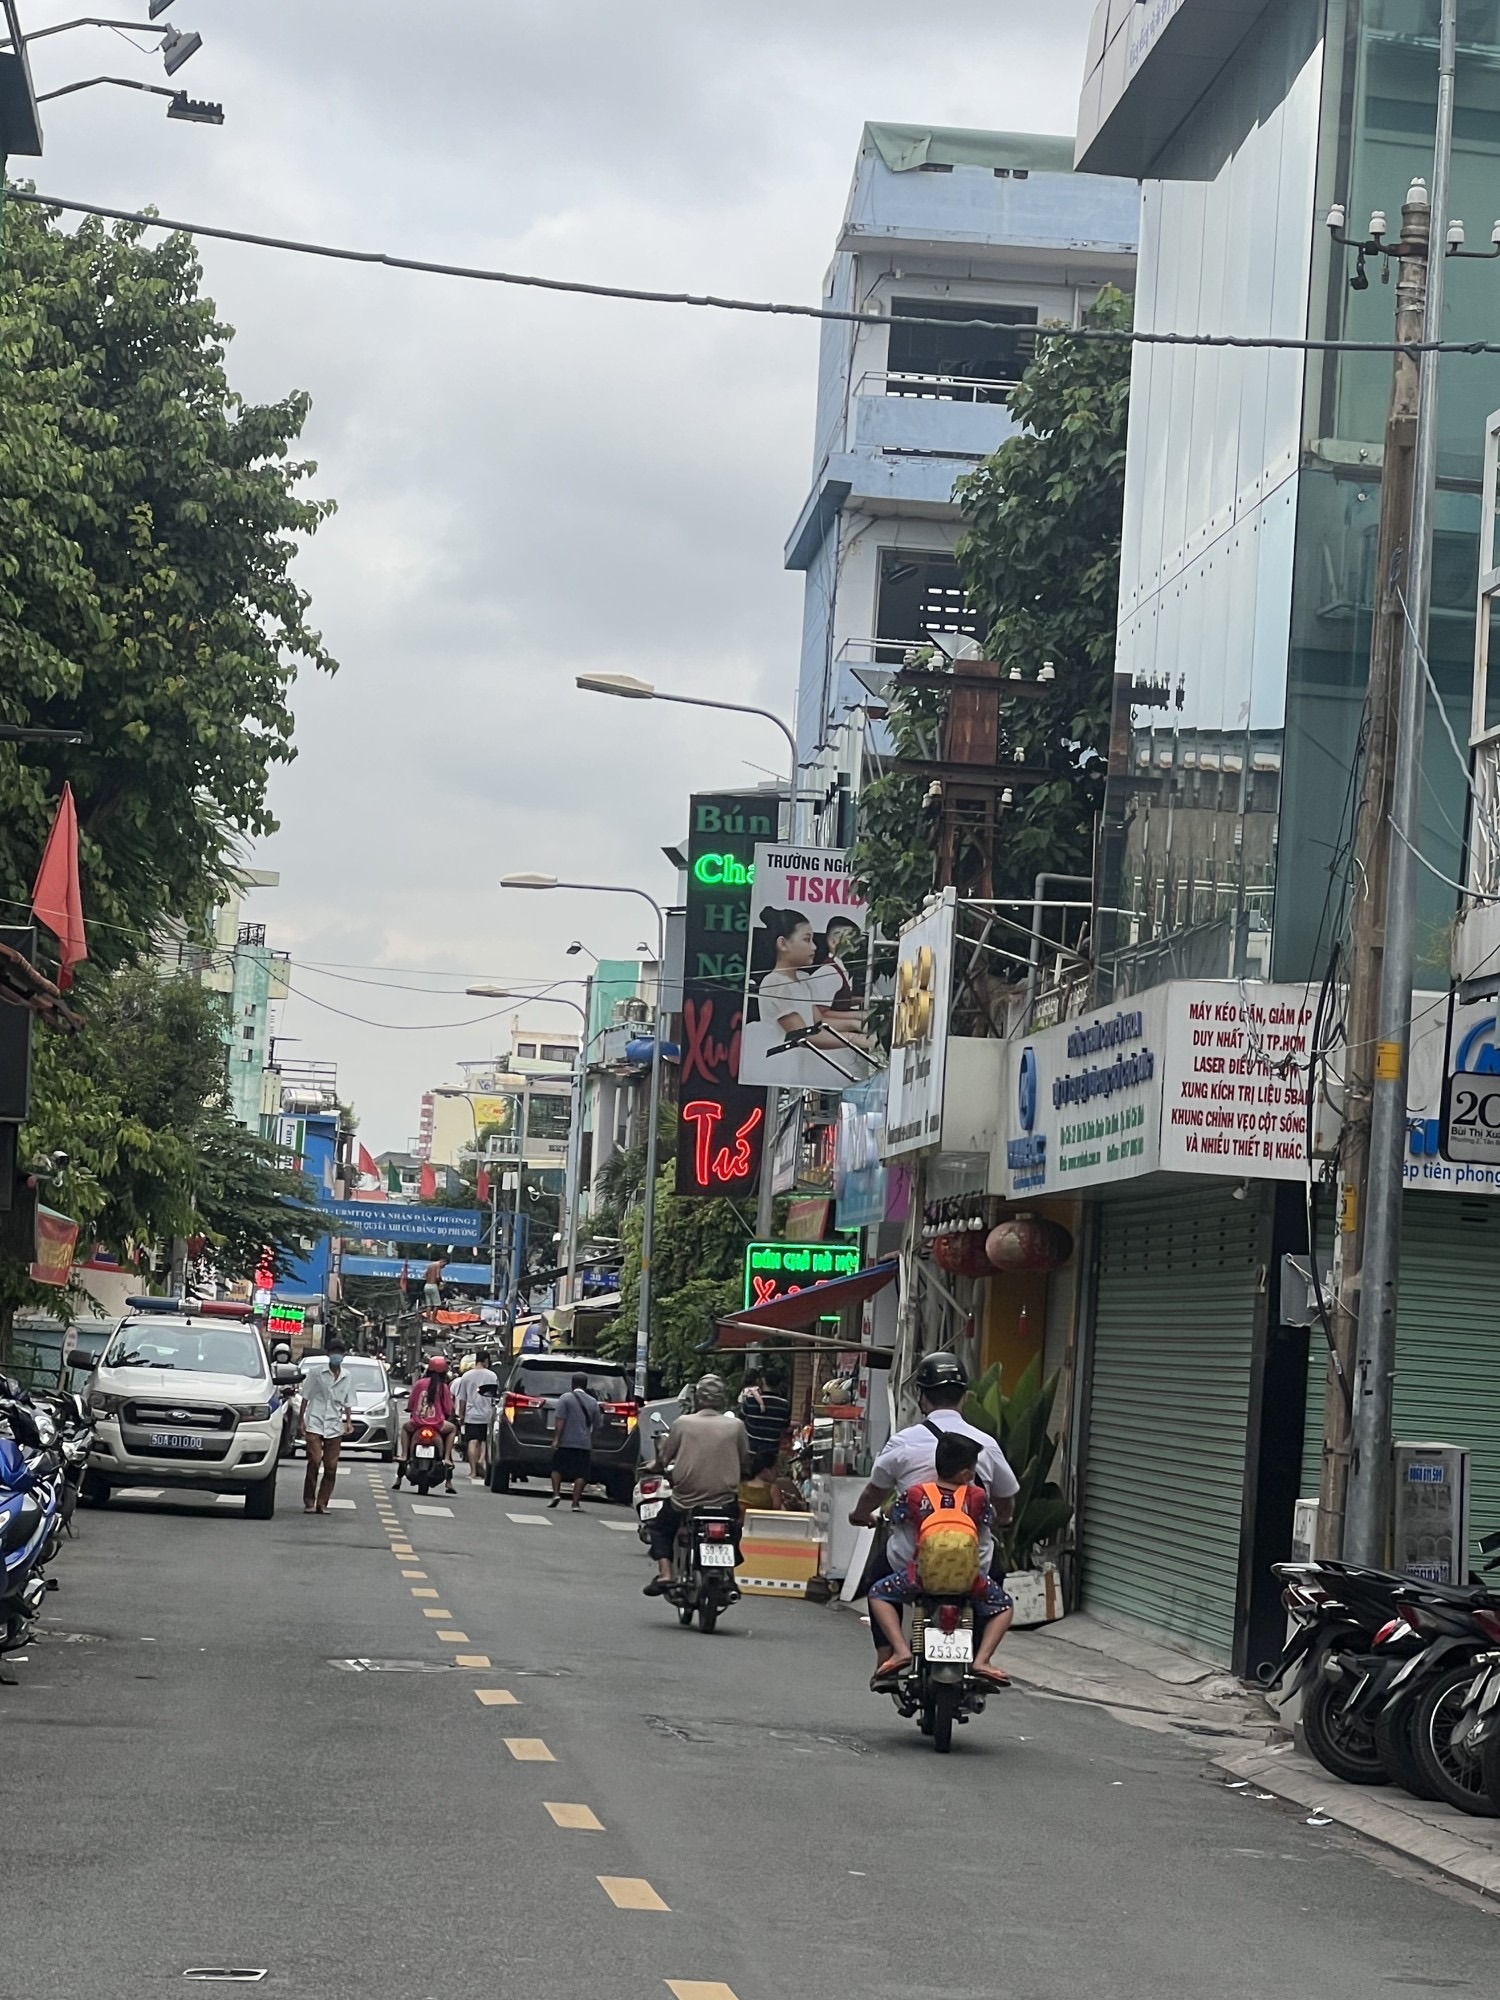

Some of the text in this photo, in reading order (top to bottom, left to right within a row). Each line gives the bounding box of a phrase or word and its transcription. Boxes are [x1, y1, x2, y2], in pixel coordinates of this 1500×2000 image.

[695, 804, 771, 835] Bún
[767, 852, 851, 873] TRƯỜNG NGH
[704, 901, 749, 932] Hà
[696, 953, 745, 989] Nộ
[1189, 1000, 1212, 1020] MÁY
[1215, 1002, 1236, 1022] KÉO
[1269, 1002, 1295, 1025] GIẢM
[1193, 1029, 1214, 1047] DUY
[1216, 1027, 1244, 1049] NHẤT
[1194, 1056, 1225, 1074] LASER
[1181, 1081, 1208, 1099] XUNG
[1211, 1080, 1234, 1101] KÍCH
[1238, 1085, 1255, 1105] TRỊ
[1258, 1084, 1281, 1106] LIỆU
[1171, 1108, 1203, 1126] KHUNG
[1206, 1106, 1234, 1128] CHỈNH
[1237, 1113, 1256, 1132] VẸO
[1258, 1112, 1277, 1134] CỘT
[683, 1100, 762, 1186] Tứ
[1186, 1132, 1198, 1153] VÀ
[1201, 1132, 1230, 1155] NHIỀU
[1232, 1135, 1260, 1157] THIẾT
[1263, 1142, 1274, 1160] BỊ
[1423, 1162, 1451, 1180] tiên
[374, 1209, 386, 1219] VÀ
[752, 1248, 782, 1269] BÚN
